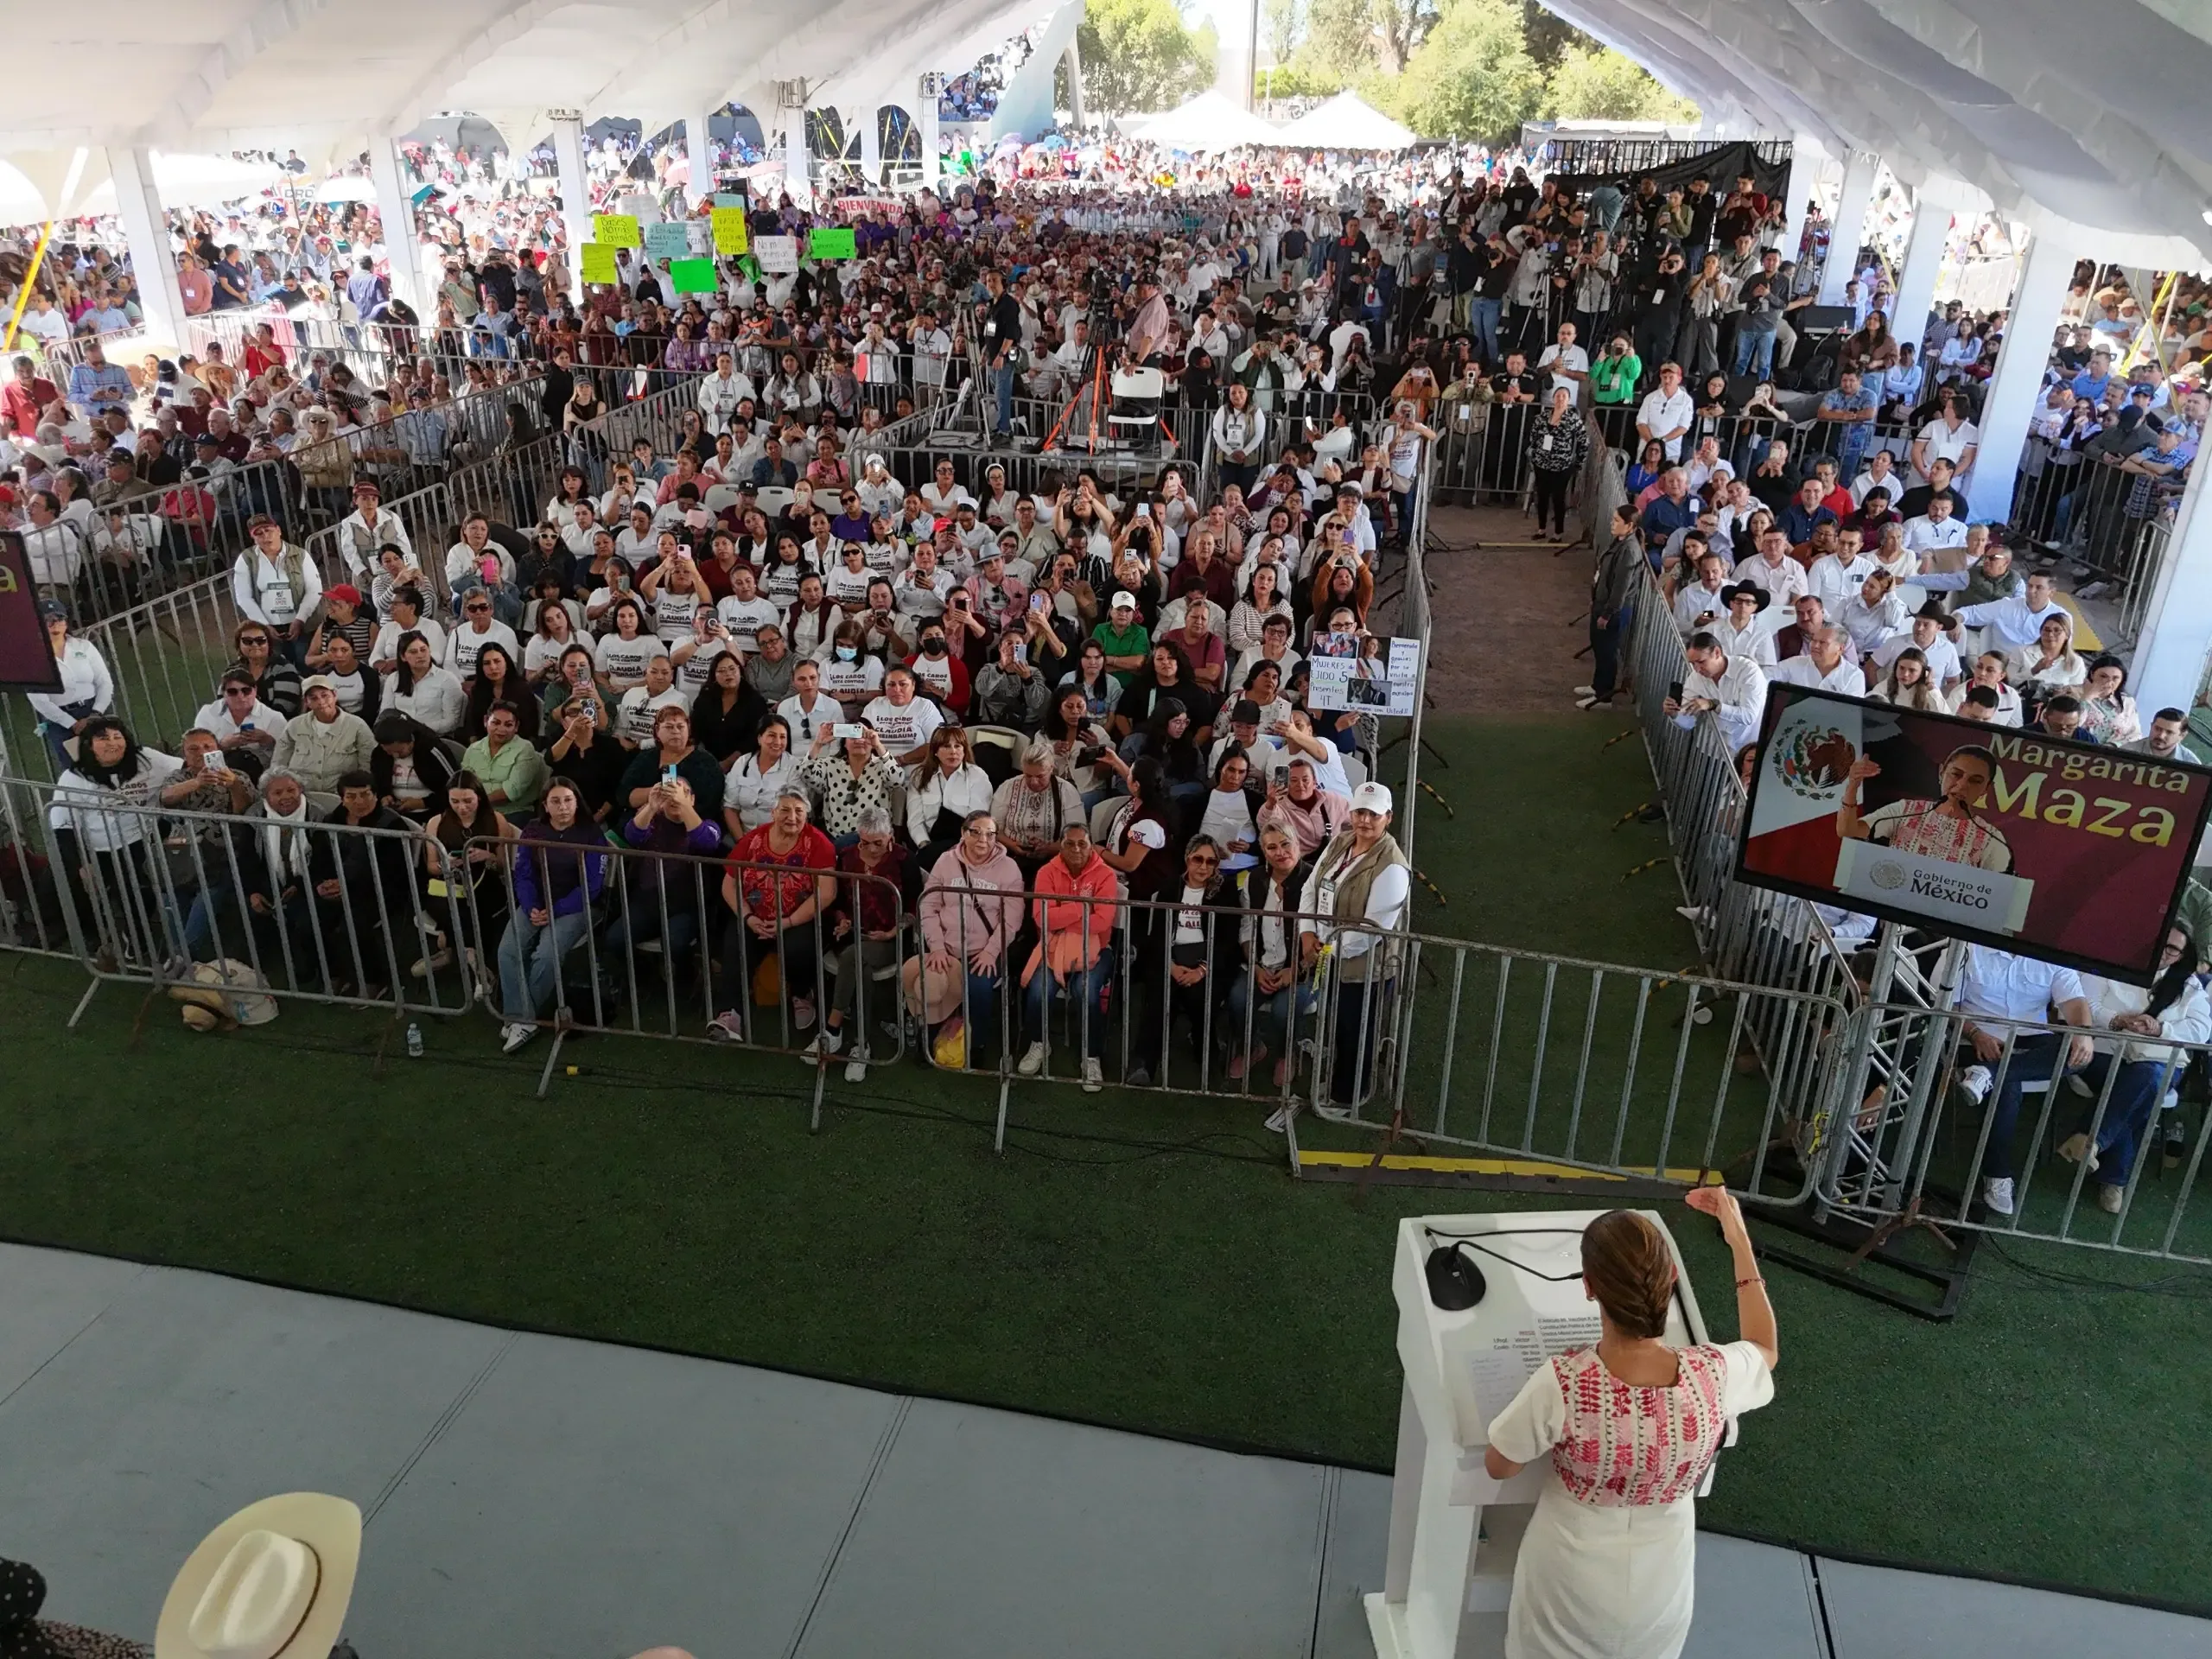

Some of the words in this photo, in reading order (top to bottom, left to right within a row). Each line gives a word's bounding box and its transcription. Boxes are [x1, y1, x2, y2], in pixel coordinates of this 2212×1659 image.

[837, 200, 905, 215] BIENVENIDA
[683, 665, 709, 674] CLAUD
[1312, 657, 1346, 670] MUJERES
[1310, 669, 1336, 681] EJIDO
[1338, 671, 1349, 683] 5
[1310, 681, 1345, 695] Presentes
[1989, 733, 2190, 794] Margarita
[1973, 764, 2176, 848] Maza
[1913, 868, 1974, 890] Gobierno
[1976, 884, 1993, 895] de
[1910, 877, 1989, 910] México
